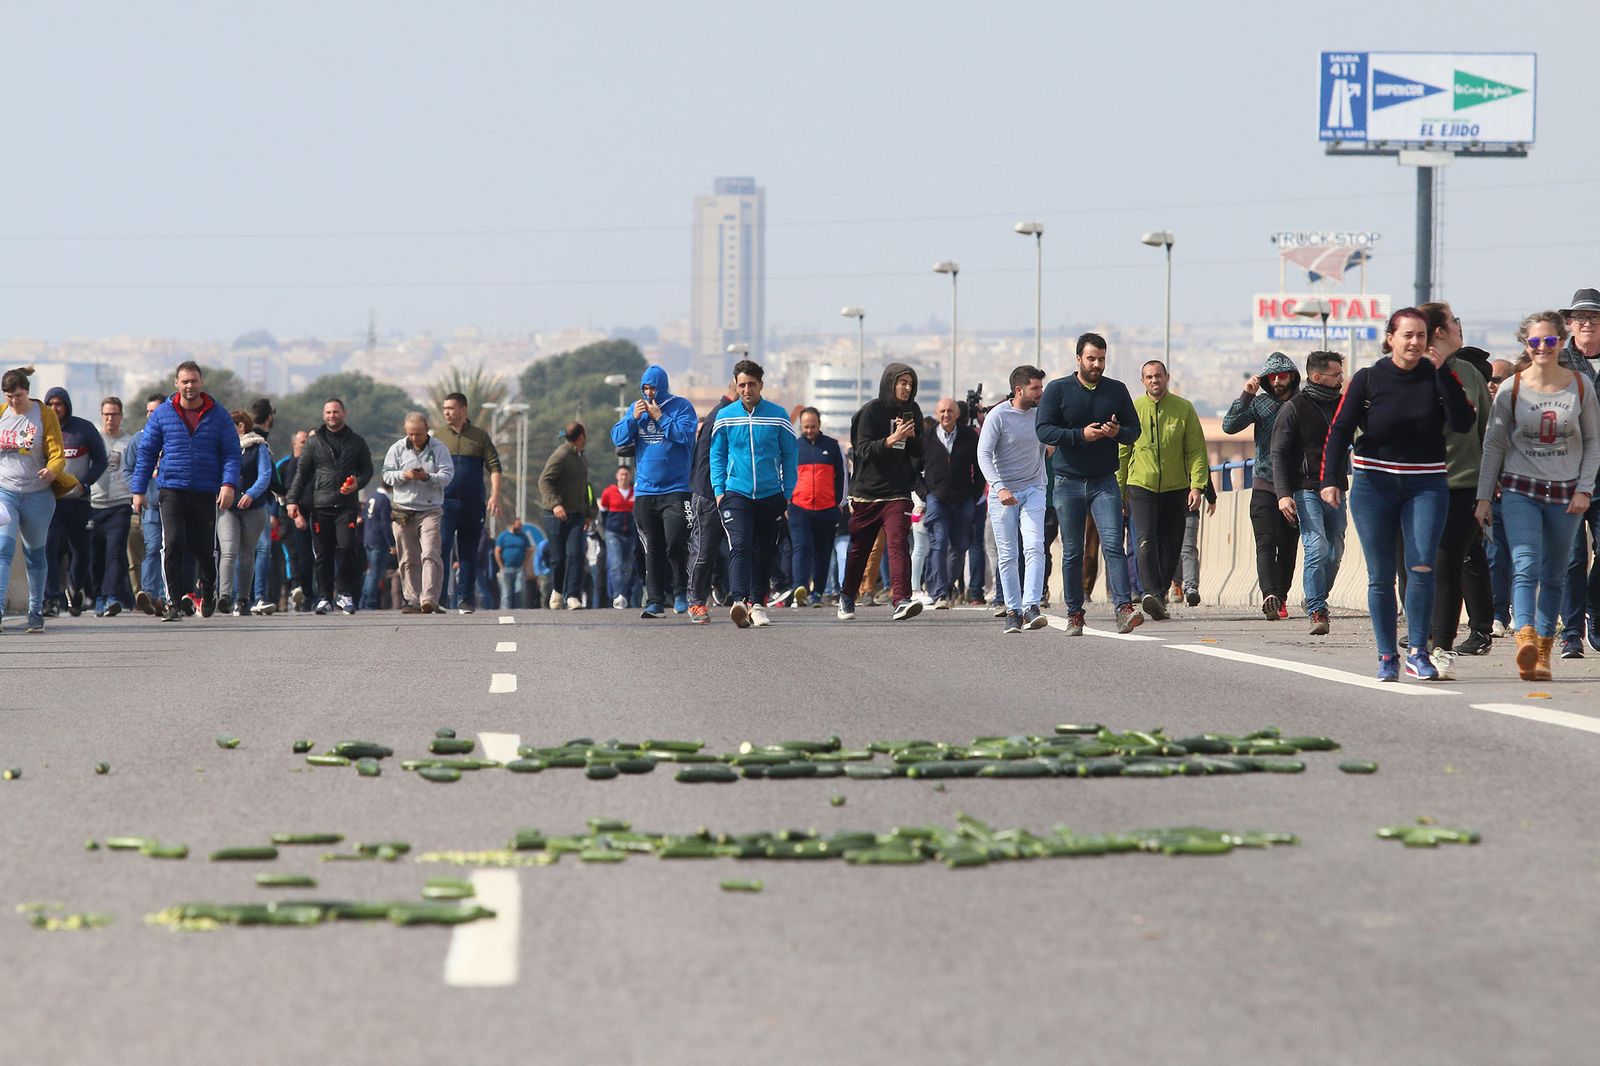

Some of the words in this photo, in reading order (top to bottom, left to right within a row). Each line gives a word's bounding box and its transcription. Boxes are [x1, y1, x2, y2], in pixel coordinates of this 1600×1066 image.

[1330, 63, 1357, 78] 411
[1421, 123, 1434, 137] EL
[1441, 123, 1480, 137] EJIDO
[1275, 231, 1331, 247] TRUCK
[1334, 232, 1382, 248] STOP
[1259, 298, 1387, 320] HOTAL
[1273, 326, 1368, 340] RESTAURANE
[683, 500, 694, 530] adidas
